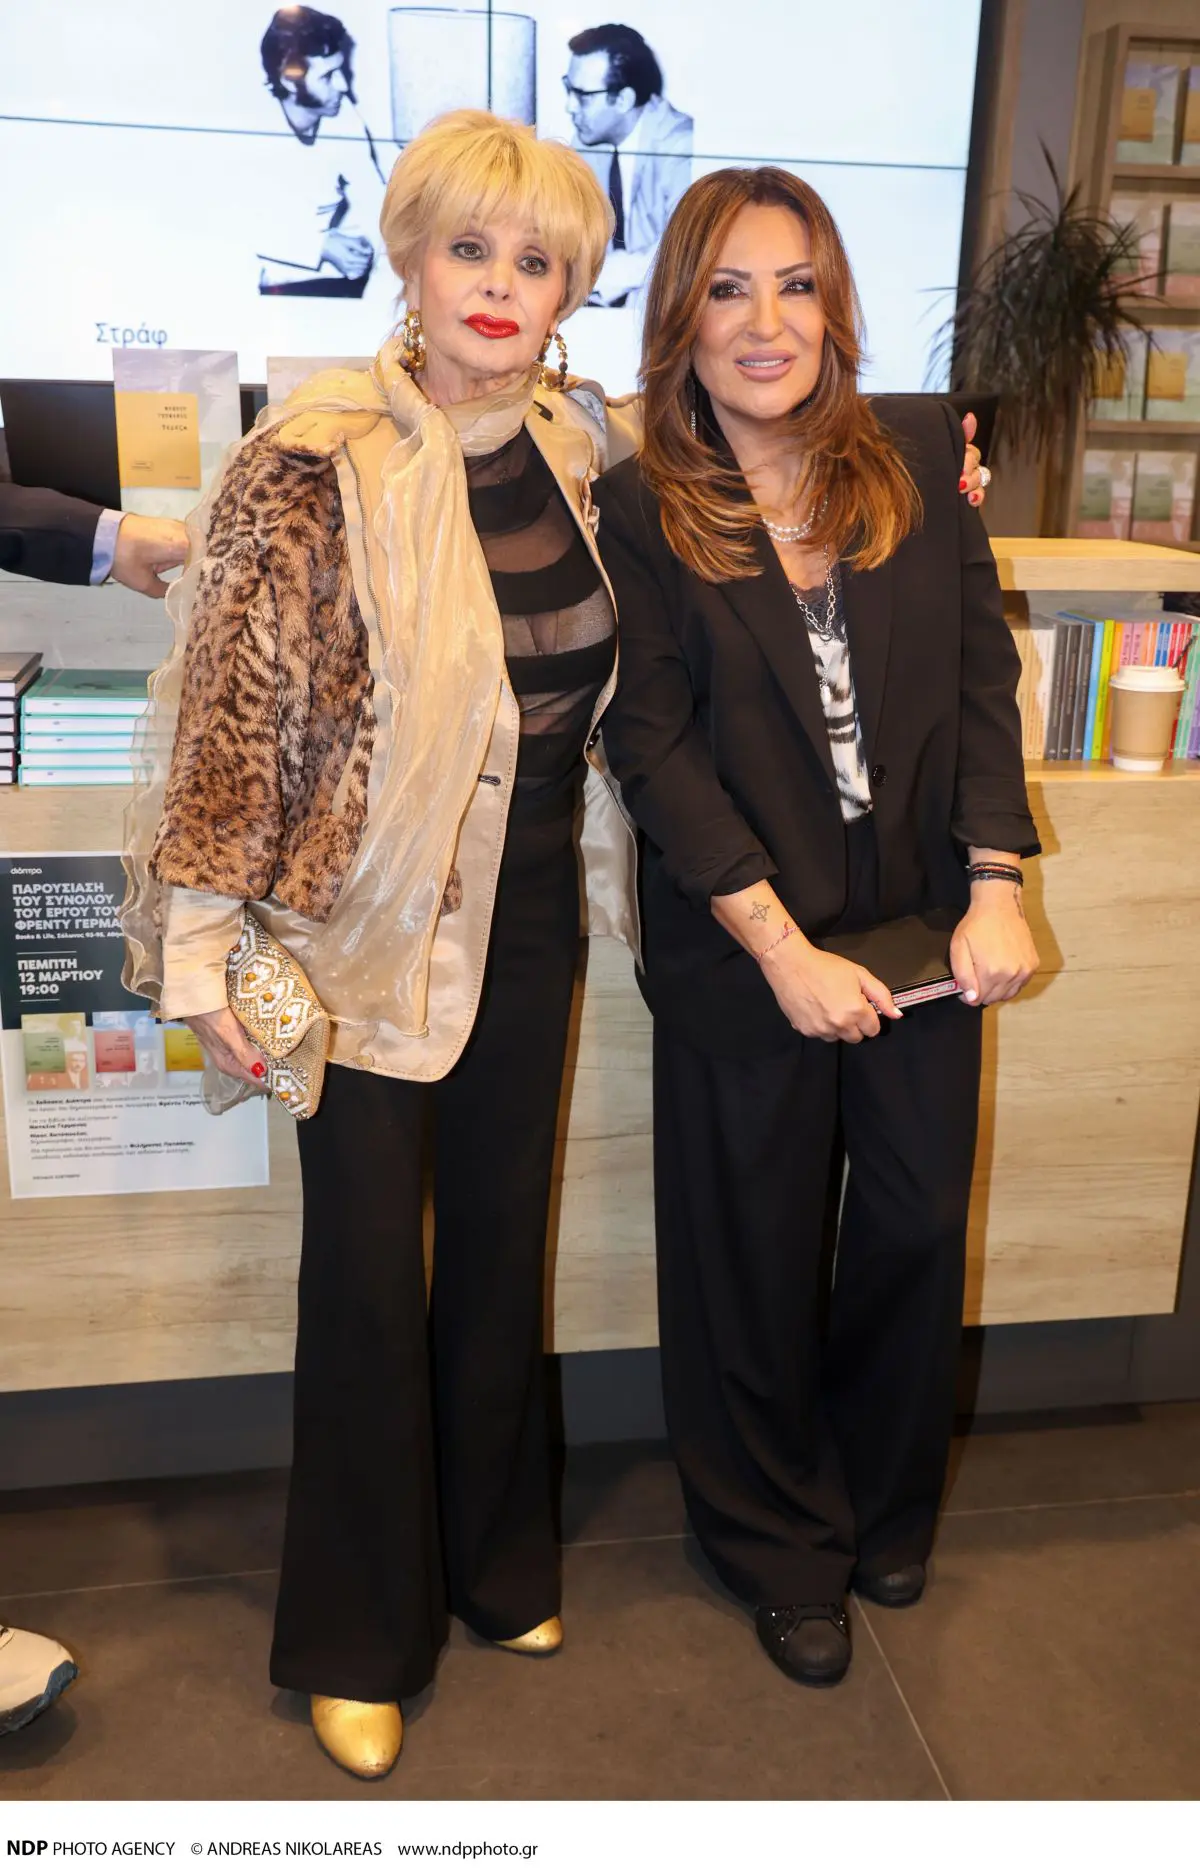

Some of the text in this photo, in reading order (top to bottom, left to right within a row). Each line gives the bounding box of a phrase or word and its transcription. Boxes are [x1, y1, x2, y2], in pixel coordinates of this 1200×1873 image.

[12, 882, 104, 895] ΠΑΡΟΥΣΙΑΣΗ
[13, 894, 114, 907] ΤΟΥ ΣΥΝΟΛΟΥ
[14, 905, 120, 919] ΤΟΥ ΕΡΓΟΥ ΤΟΥ
[14, 919, 71, 931] ΦΡΕΝΤΥ
[18, 958, 77, 970] ΠΕΜΠΤΗ
[19, 969, 103, 982] 12 ΜΑΡΤΙΟΥ
[20, 983, 59, 995] 19:00
